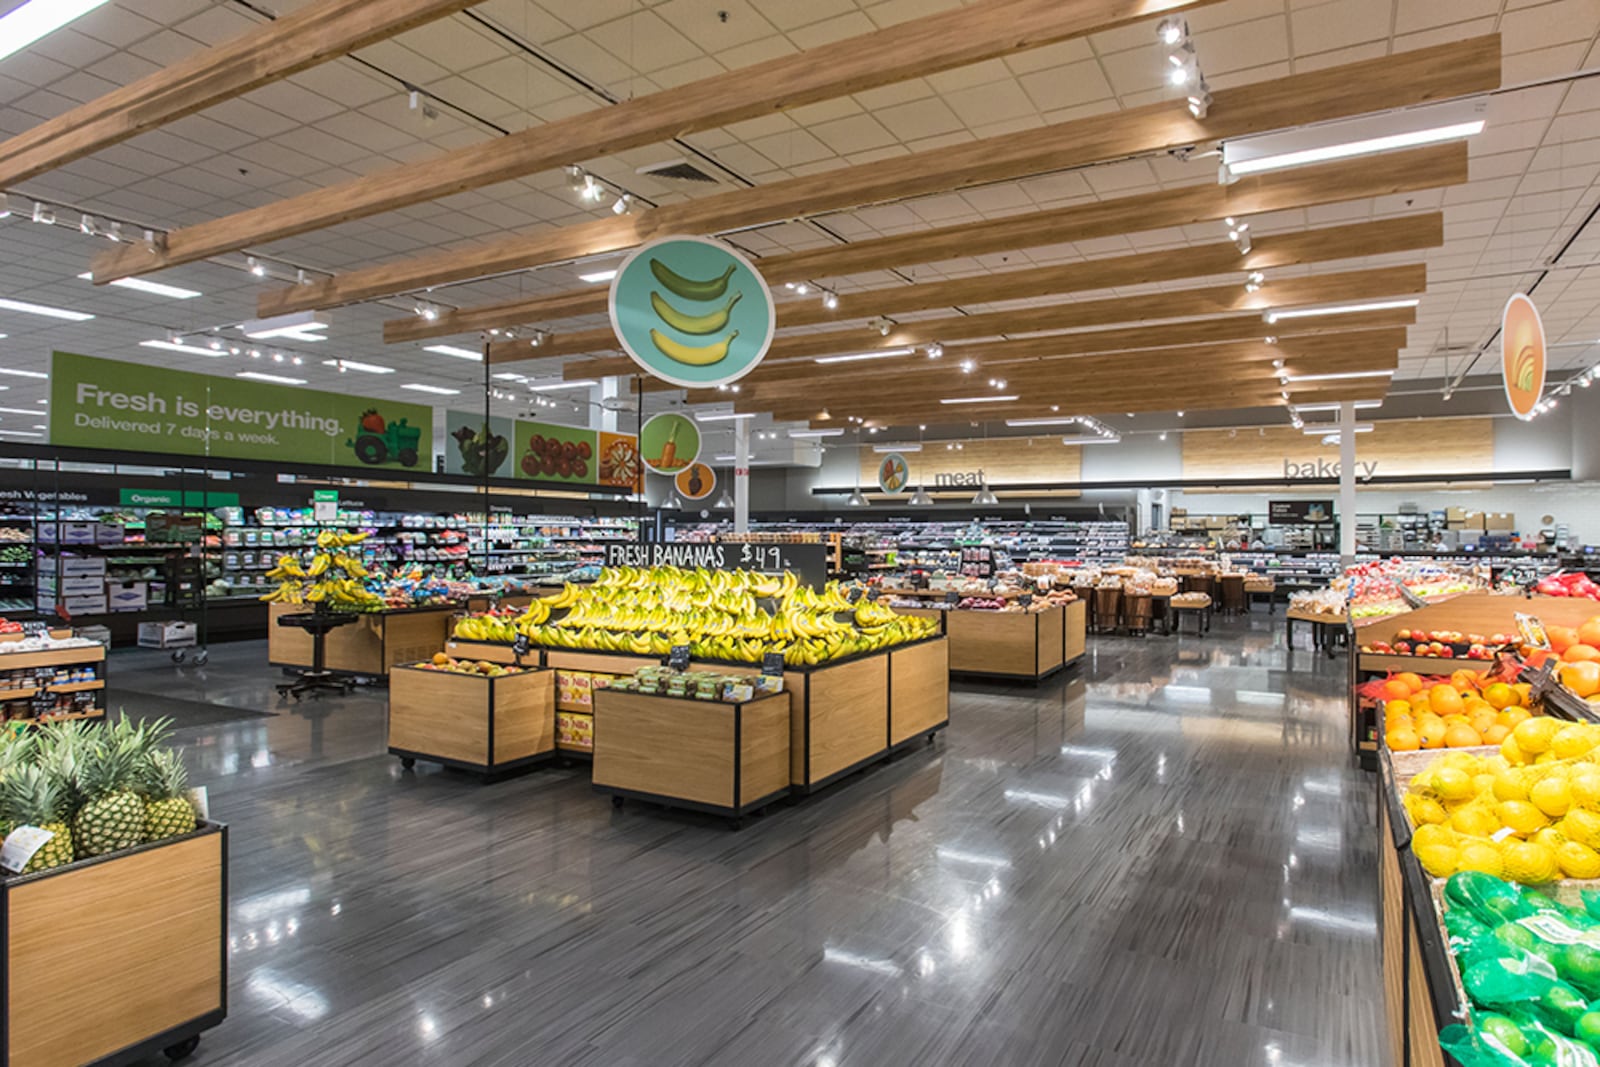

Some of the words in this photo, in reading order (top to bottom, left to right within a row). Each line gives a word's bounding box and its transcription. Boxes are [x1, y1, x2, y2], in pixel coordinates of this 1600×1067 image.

[76, 382, 167, 414] Fresh
[176, 395, 199, 418] is
[208, 404, 344, 437] everything.
[74, 413, 161, 434] Delivered
[166, 423, 176, 436] 7
[181, 426, 220, 442] days
[224, 431, 234, 441] a
[238, 433, 280, 446] week.
[935, 468, 984, 488] meat
[131, 494, 171, 504] Organic
[609, 544, 649, 566] FRESH
[652, 544, 725, 568] BANANAS
[740, 542, 781, 569] $.49
